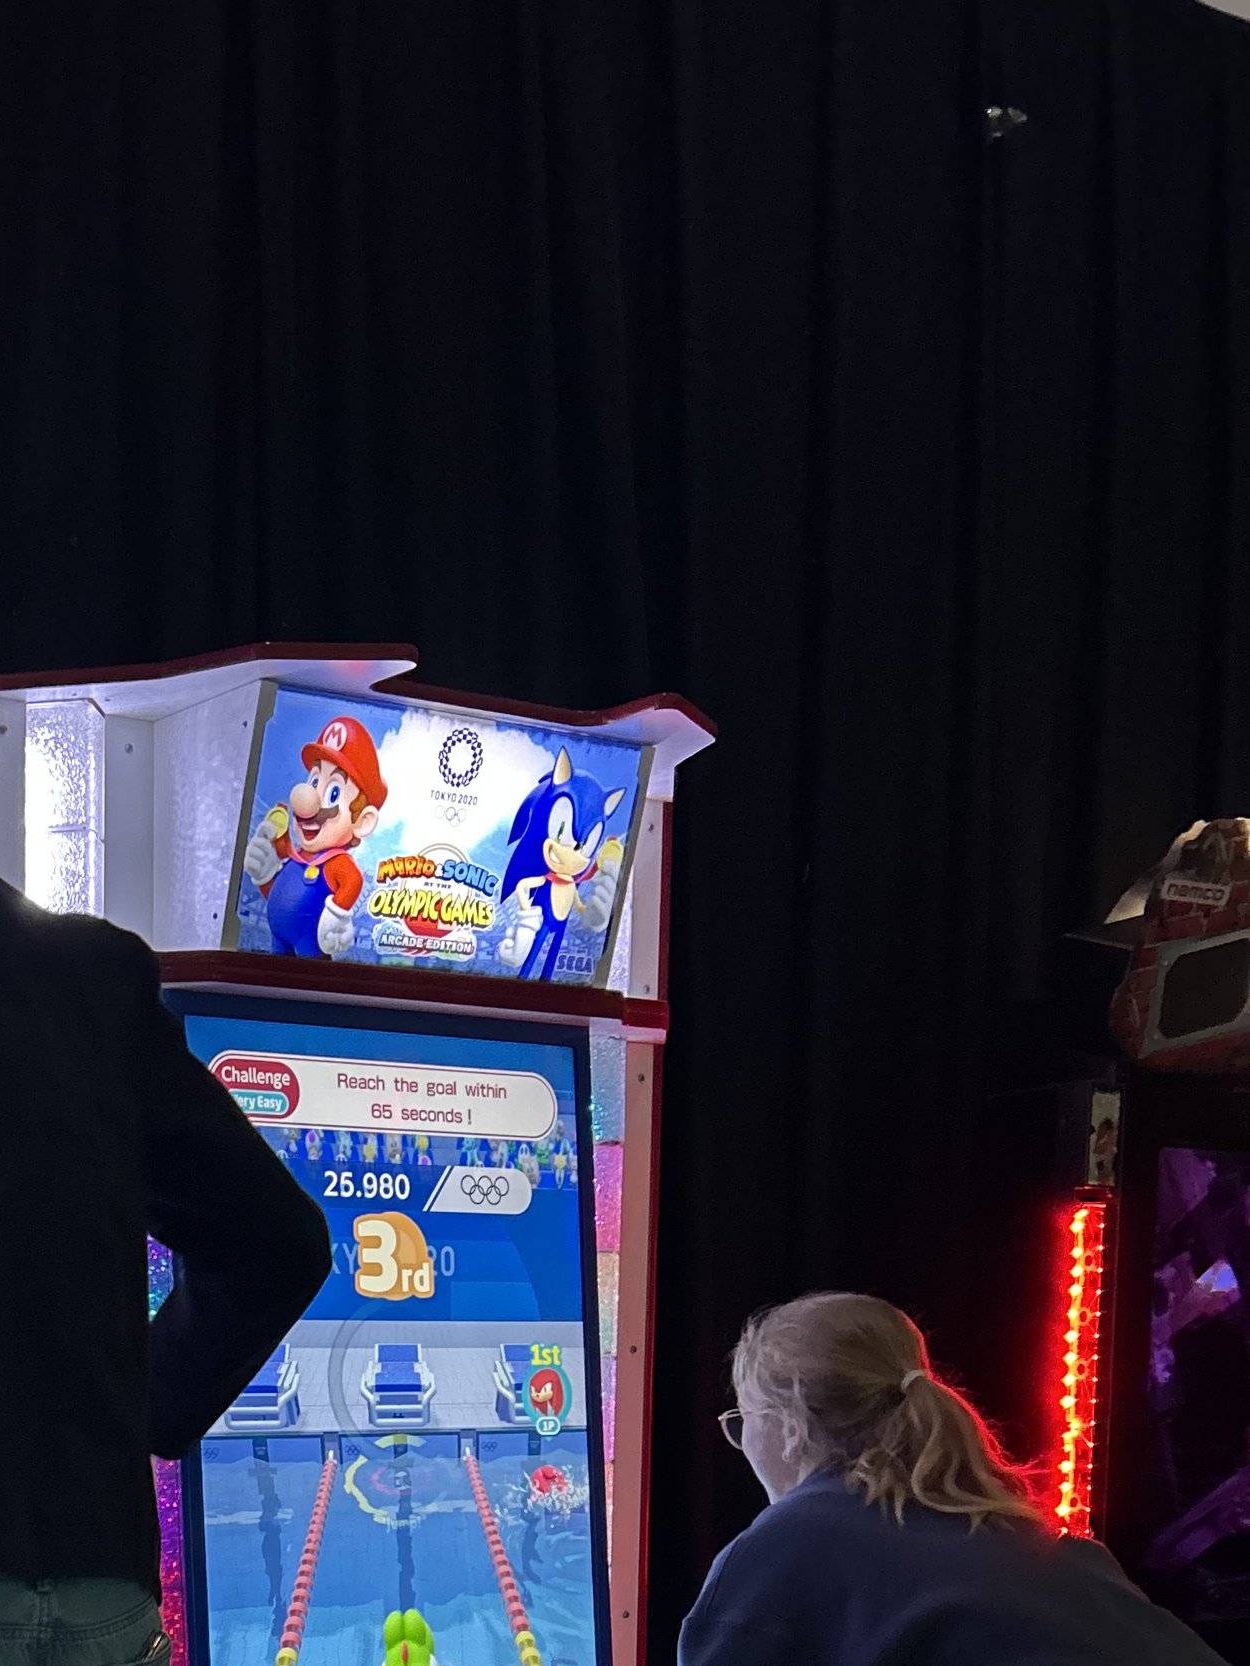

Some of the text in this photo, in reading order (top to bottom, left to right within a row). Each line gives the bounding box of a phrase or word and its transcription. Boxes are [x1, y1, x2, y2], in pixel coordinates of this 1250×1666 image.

[430, 789, 478, 806] TOKYO 2020
[376, 856, 434, 884] MARIO
[442, 859, 499, 897] SONIC
[369, 889, 495, 930] OLYMPIC GAMES
[380, 934, 473, 954] ARCADE EDITION
[556, 954, 593, 974] SEGA
[221, 1065, 290, 1089] Challenge
[337, 1073, 507, 1099] Reach the goal within
[257, 1095, 283, 1112] Easy
[371, 1103, 393, 1120] 65
[357, 1219, 431, 1293] 3rd
[531, 1343, 561, 1366] 1st
[542, 1420, 555, 1432] 1P
